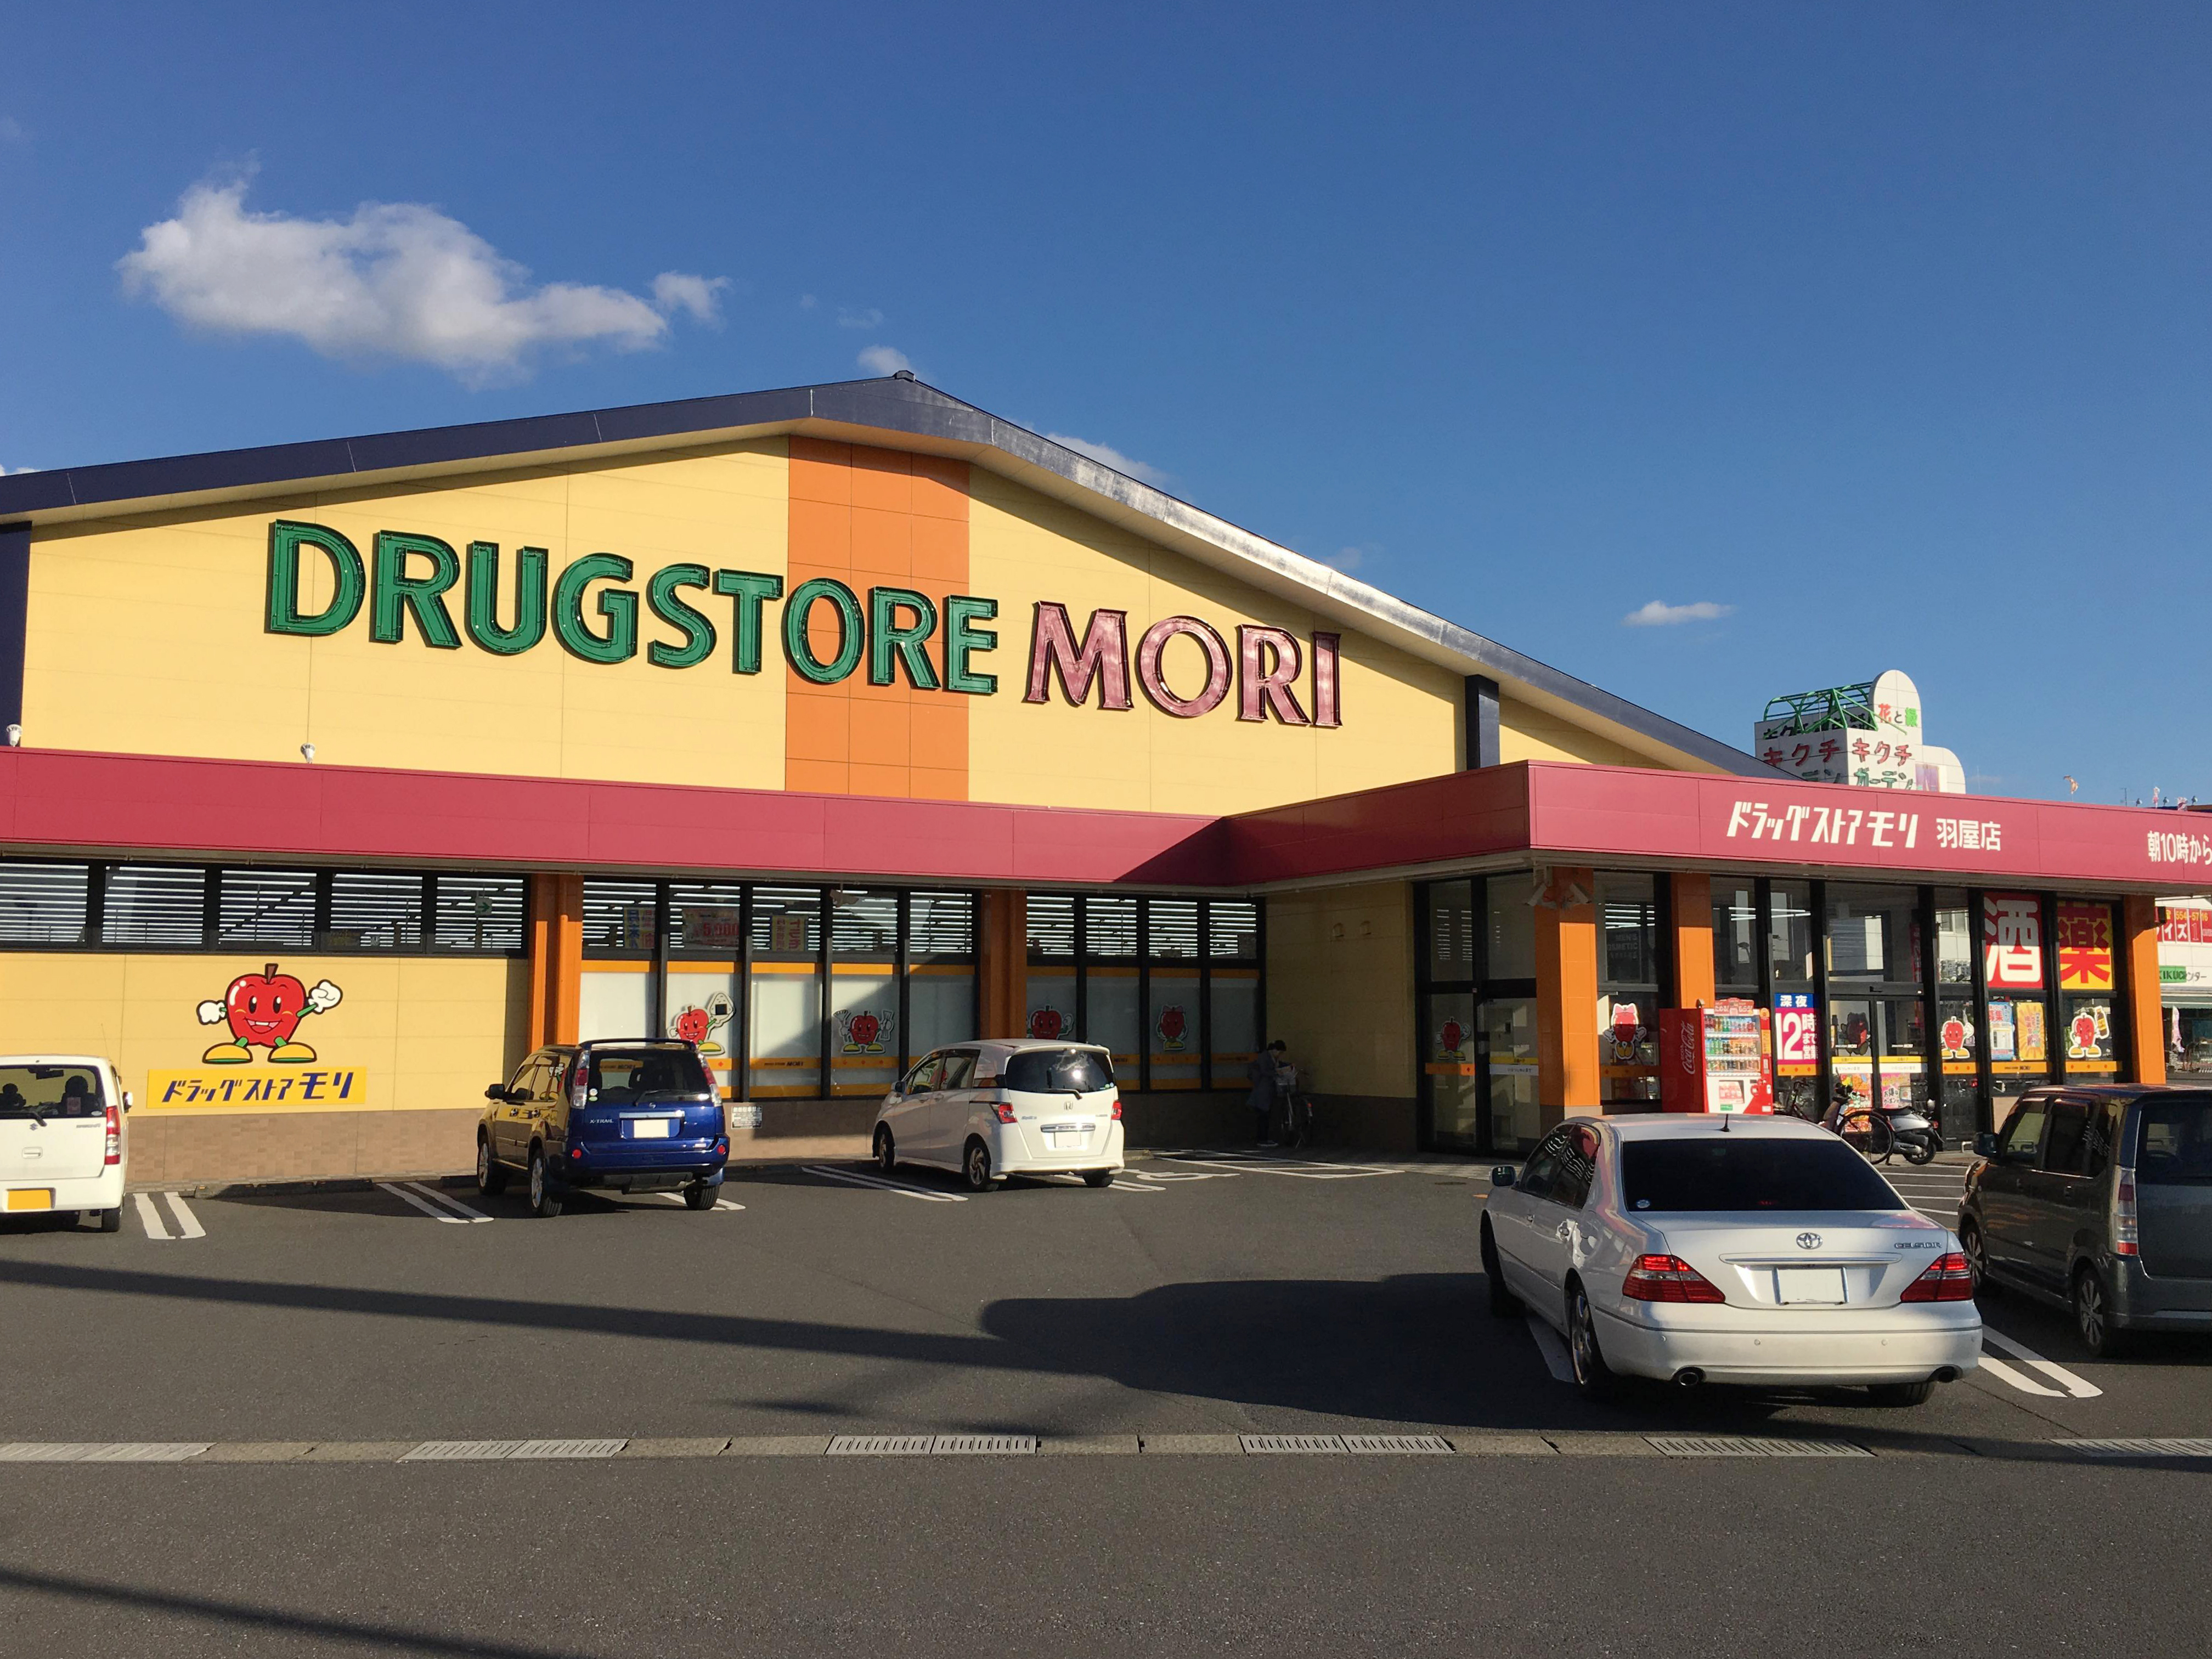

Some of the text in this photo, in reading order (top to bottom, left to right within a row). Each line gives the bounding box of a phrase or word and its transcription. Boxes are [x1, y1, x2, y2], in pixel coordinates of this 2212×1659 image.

[264, 518, 1343, 727] DRUGSTORE MORI
[1763, 739, 1839, 767] キクチ
[1852, 737, 1912, 767] キクチ
[1726, 801, 2001, 851] ドラッグストアモリ 羽屋店
[2147, 830, 2212, 865] 朝10時から
[1984, 896, 2041, 982] 酒
[2058, 901, 2111, 984] 薬
[1780, 995, 1808, 1008] 深夜
[1775, 1012, 1803, 1060] 12
[1802, 1013, 1818, 1032] 時
[162, 1071, 354, 1103] ドラッグストアモリ
